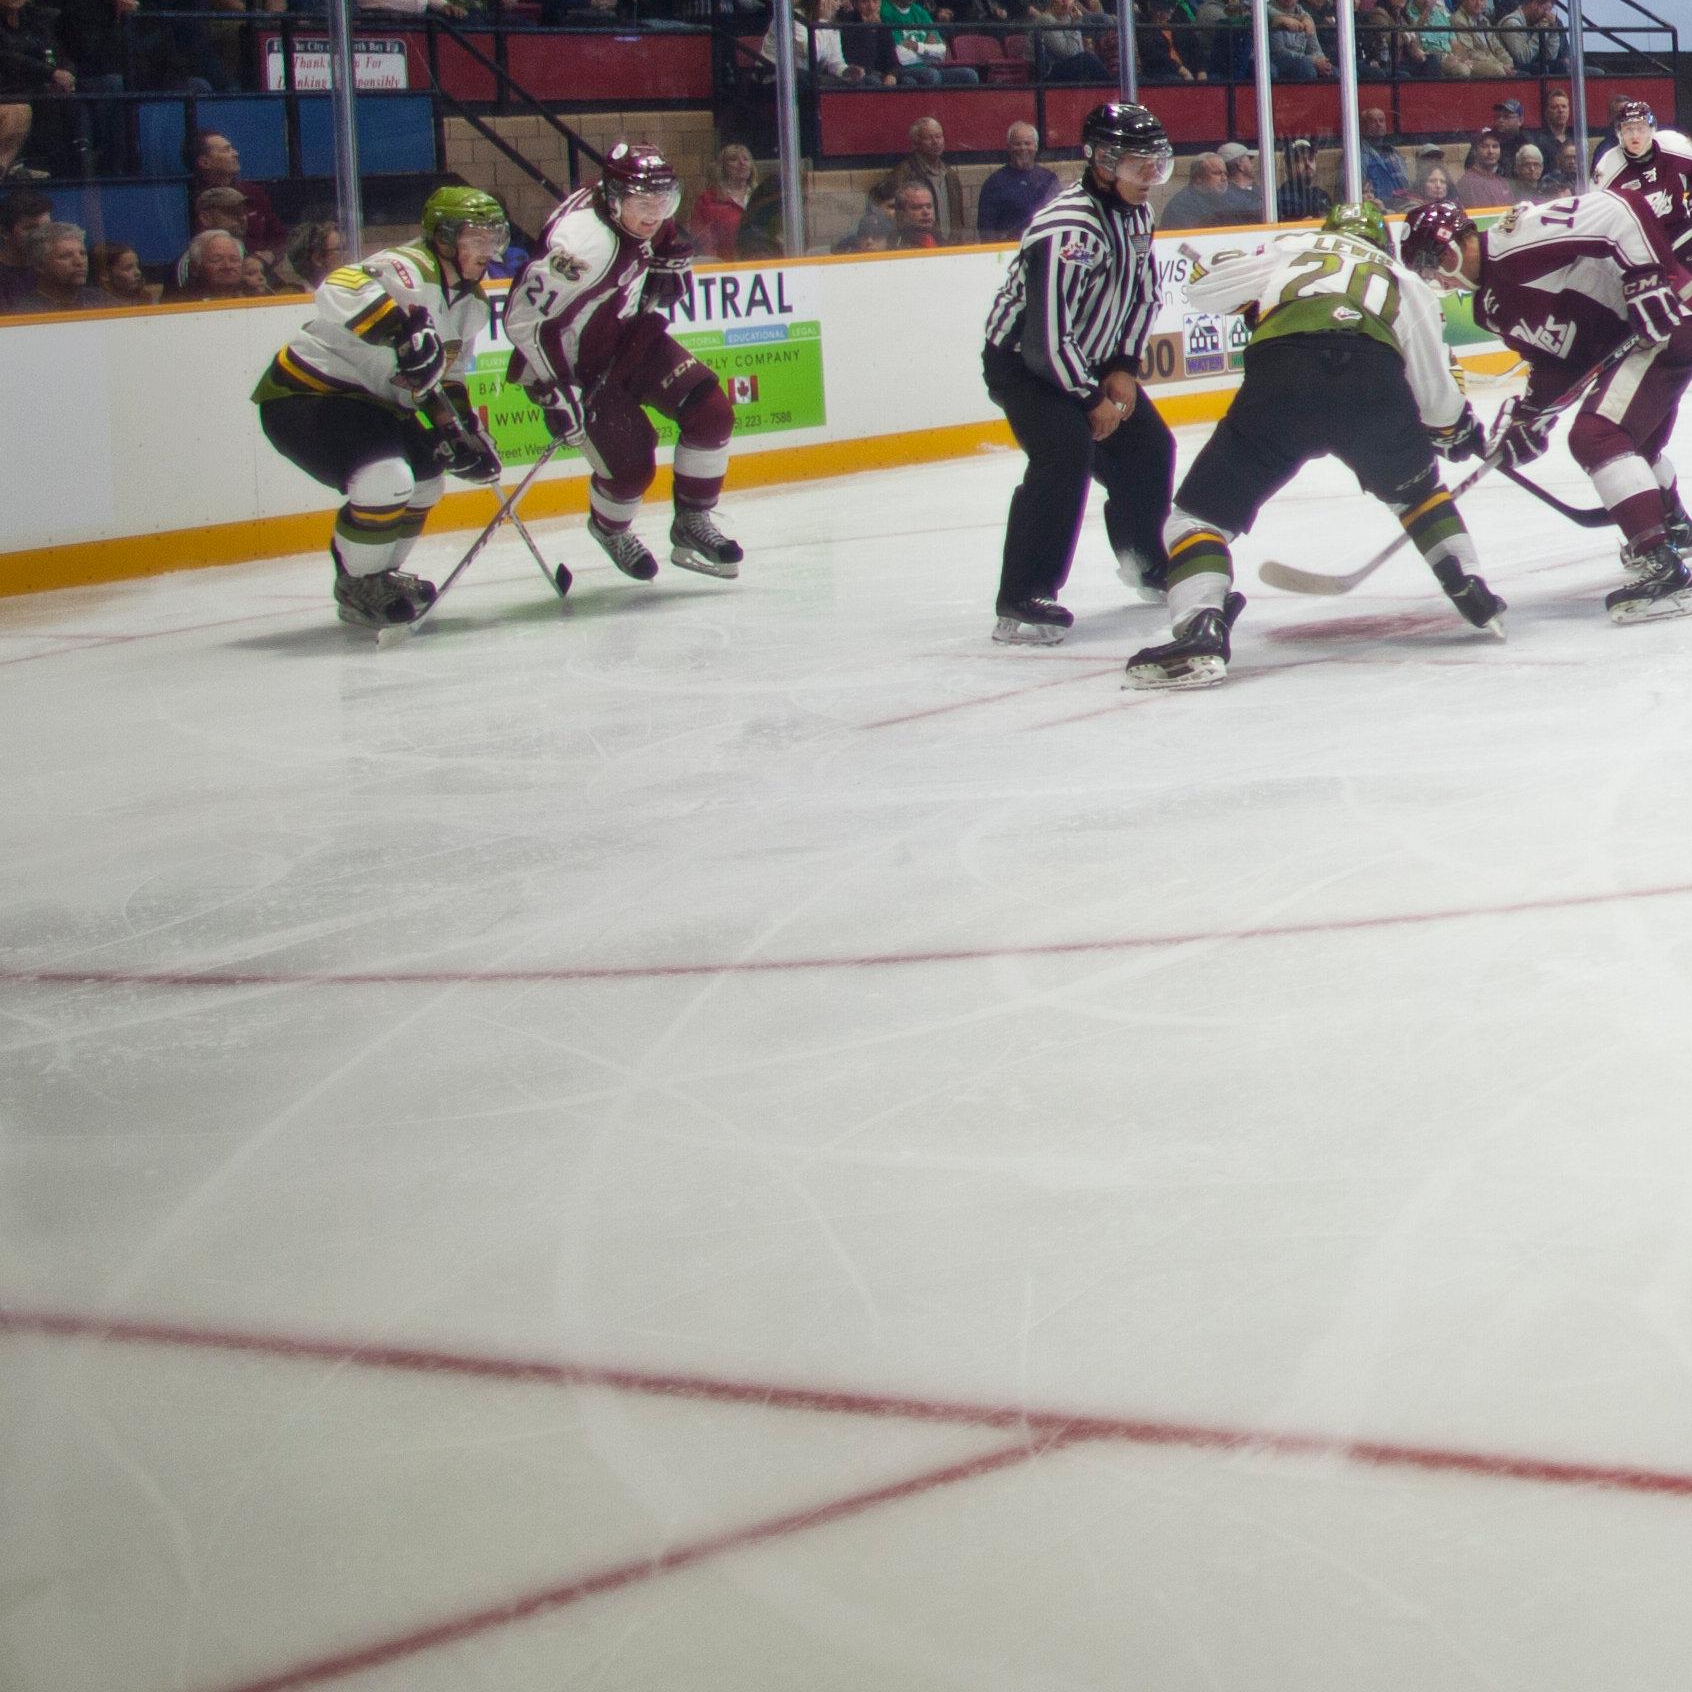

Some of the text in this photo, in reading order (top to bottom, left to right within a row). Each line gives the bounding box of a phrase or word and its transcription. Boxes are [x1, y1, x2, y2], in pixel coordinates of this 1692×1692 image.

[526, 275, 559, 317] 21
[1280, 251, 1402, 326] 20
[728, 326, 818, 344] EDUCATIONAL LEGAL
[479, 349, 801, 396] BAY COMPANY
[660, 358, 698, 389] CCM
[1187, 357, 1224, 372] WATER
[744, 414, 762, 427] 223
